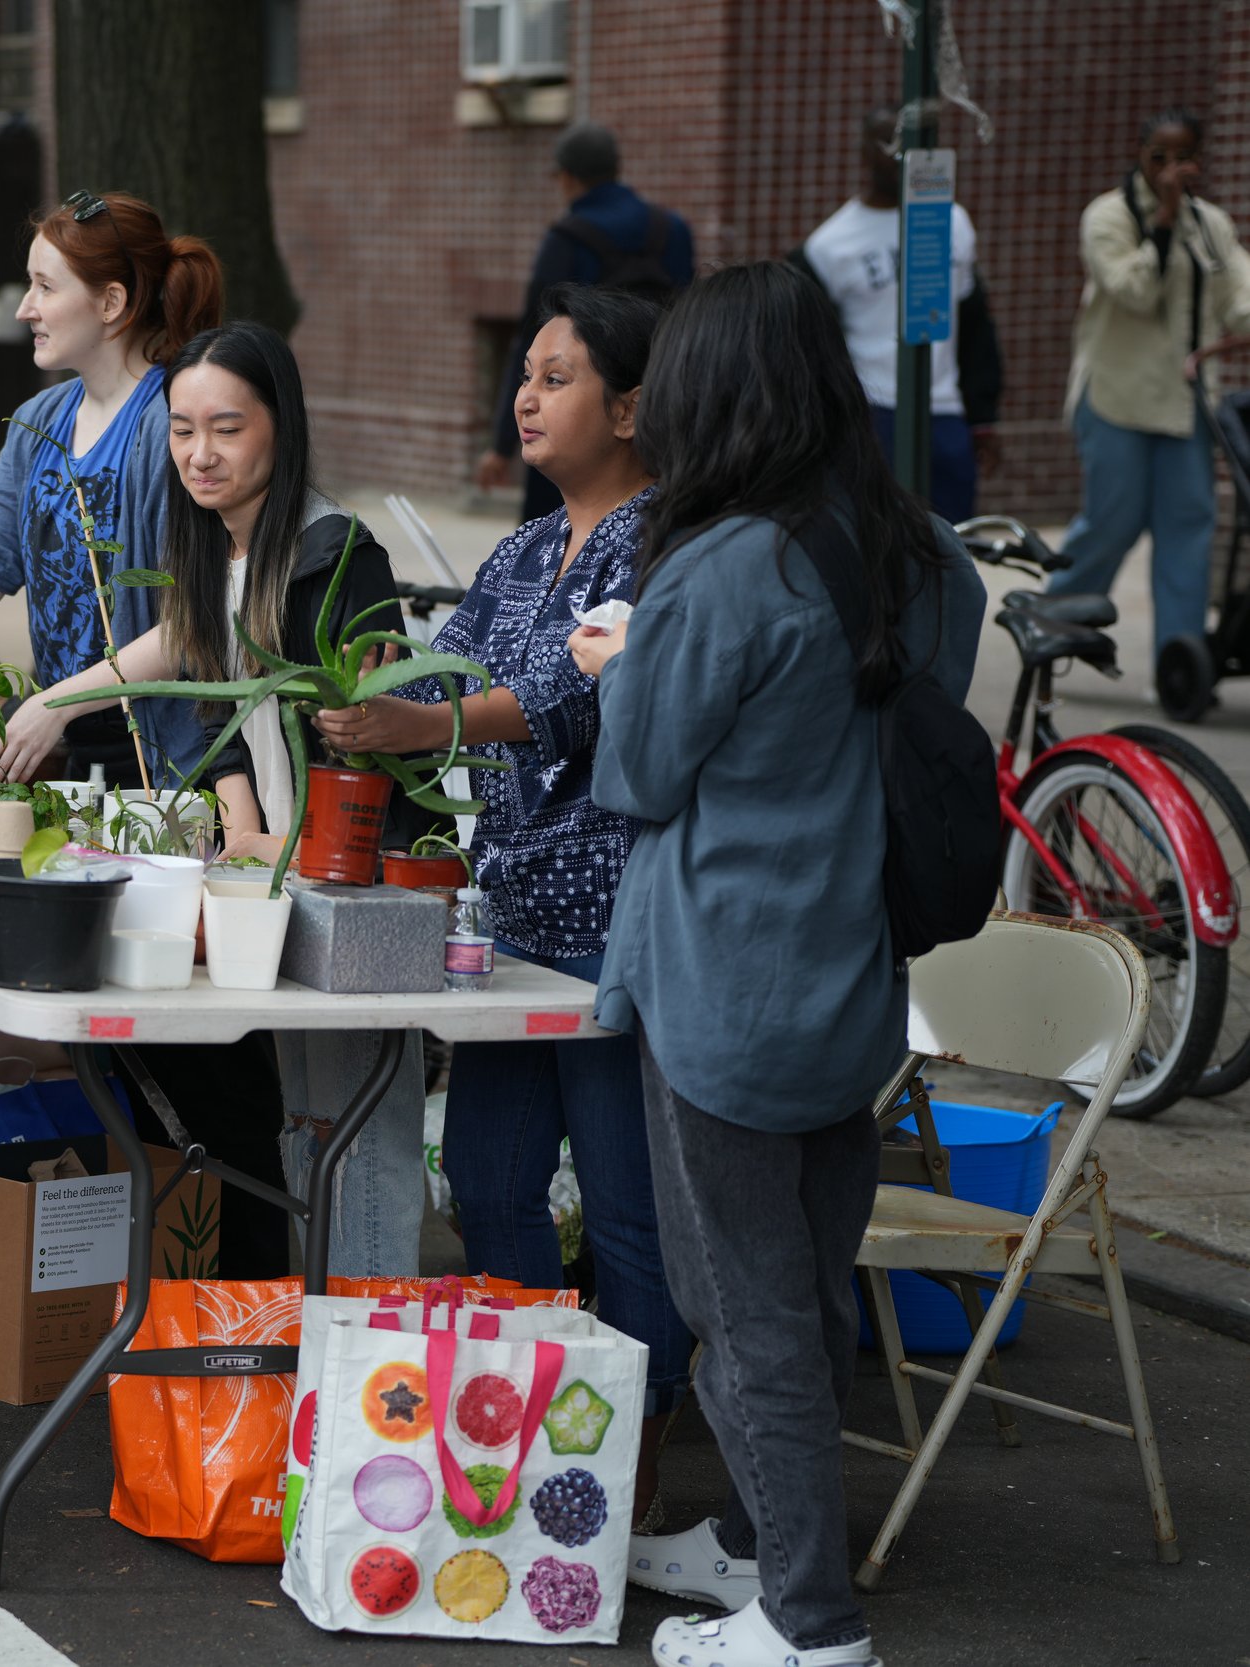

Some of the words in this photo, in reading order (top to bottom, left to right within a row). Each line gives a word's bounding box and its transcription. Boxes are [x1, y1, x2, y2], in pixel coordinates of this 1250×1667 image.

[42, 1189, 61, 1201] Feel
[63, 1188, 78, 1198] the
[80, 1184, 124, 1197] difference
[210, 1358, 255, 1366] LIFETIME
[250, 1496, 285, 1518] TH
